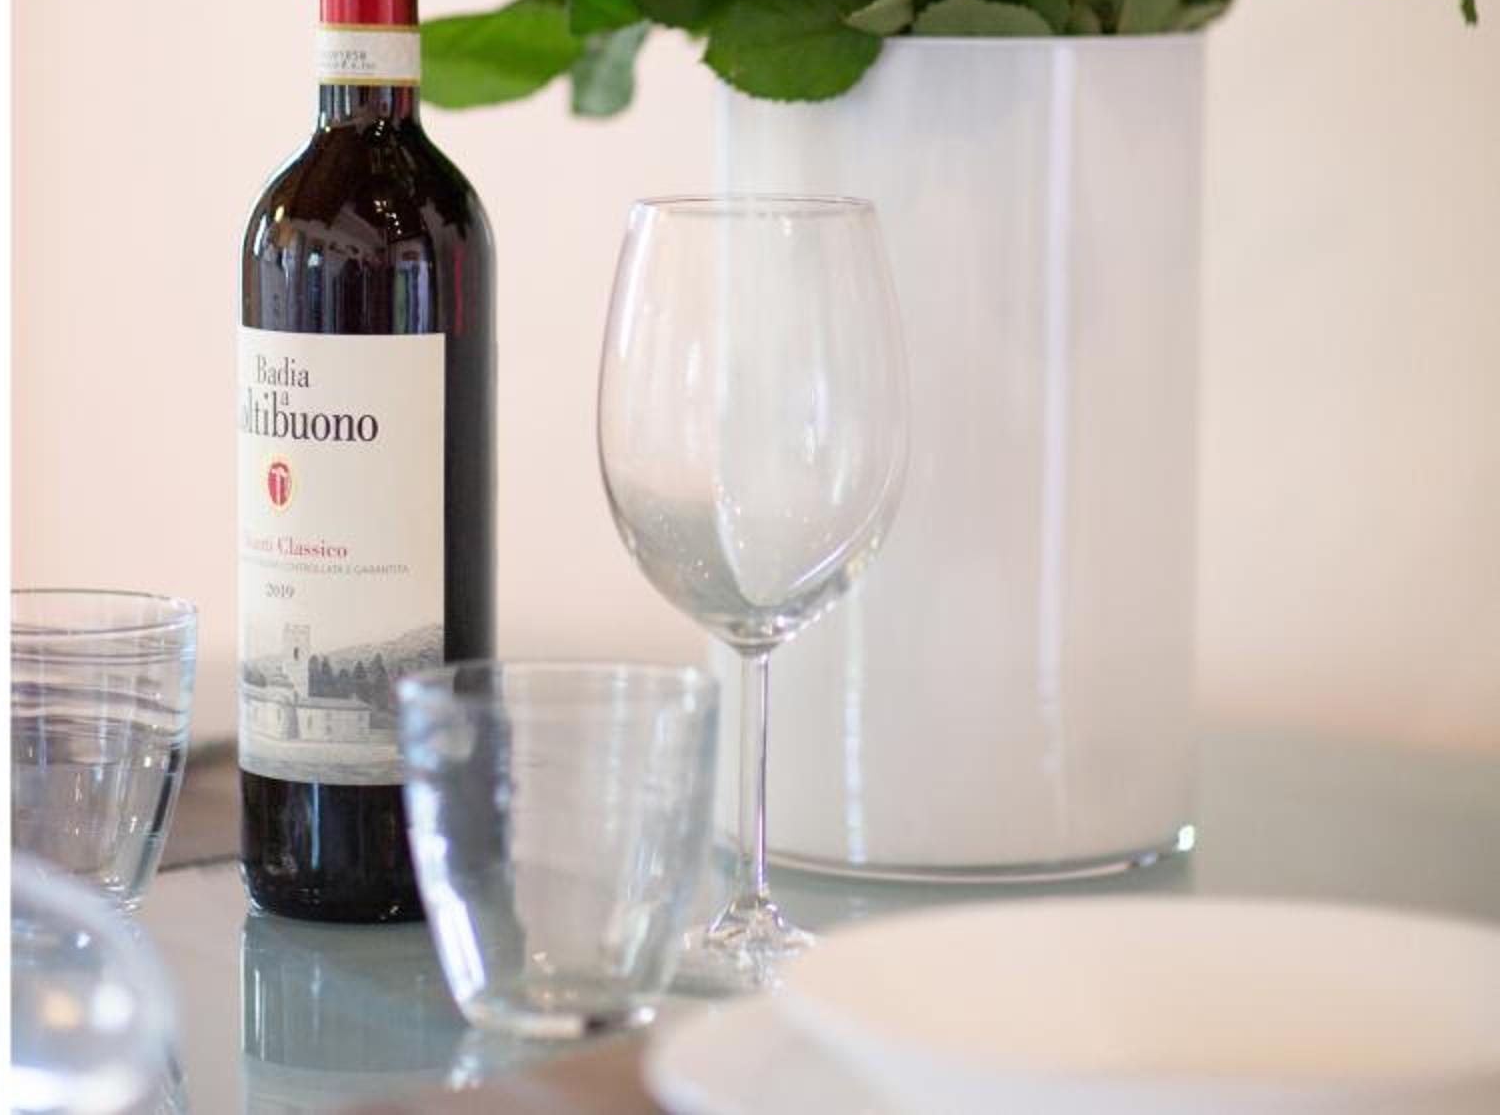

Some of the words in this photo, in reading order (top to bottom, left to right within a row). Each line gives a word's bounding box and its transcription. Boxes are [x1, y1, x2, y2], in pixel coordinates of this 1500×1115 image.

[257, 354, 310, 388] Badia
[277, 536, 348, 558] Classico
[354, 564, 409, 576] GARANTITA
